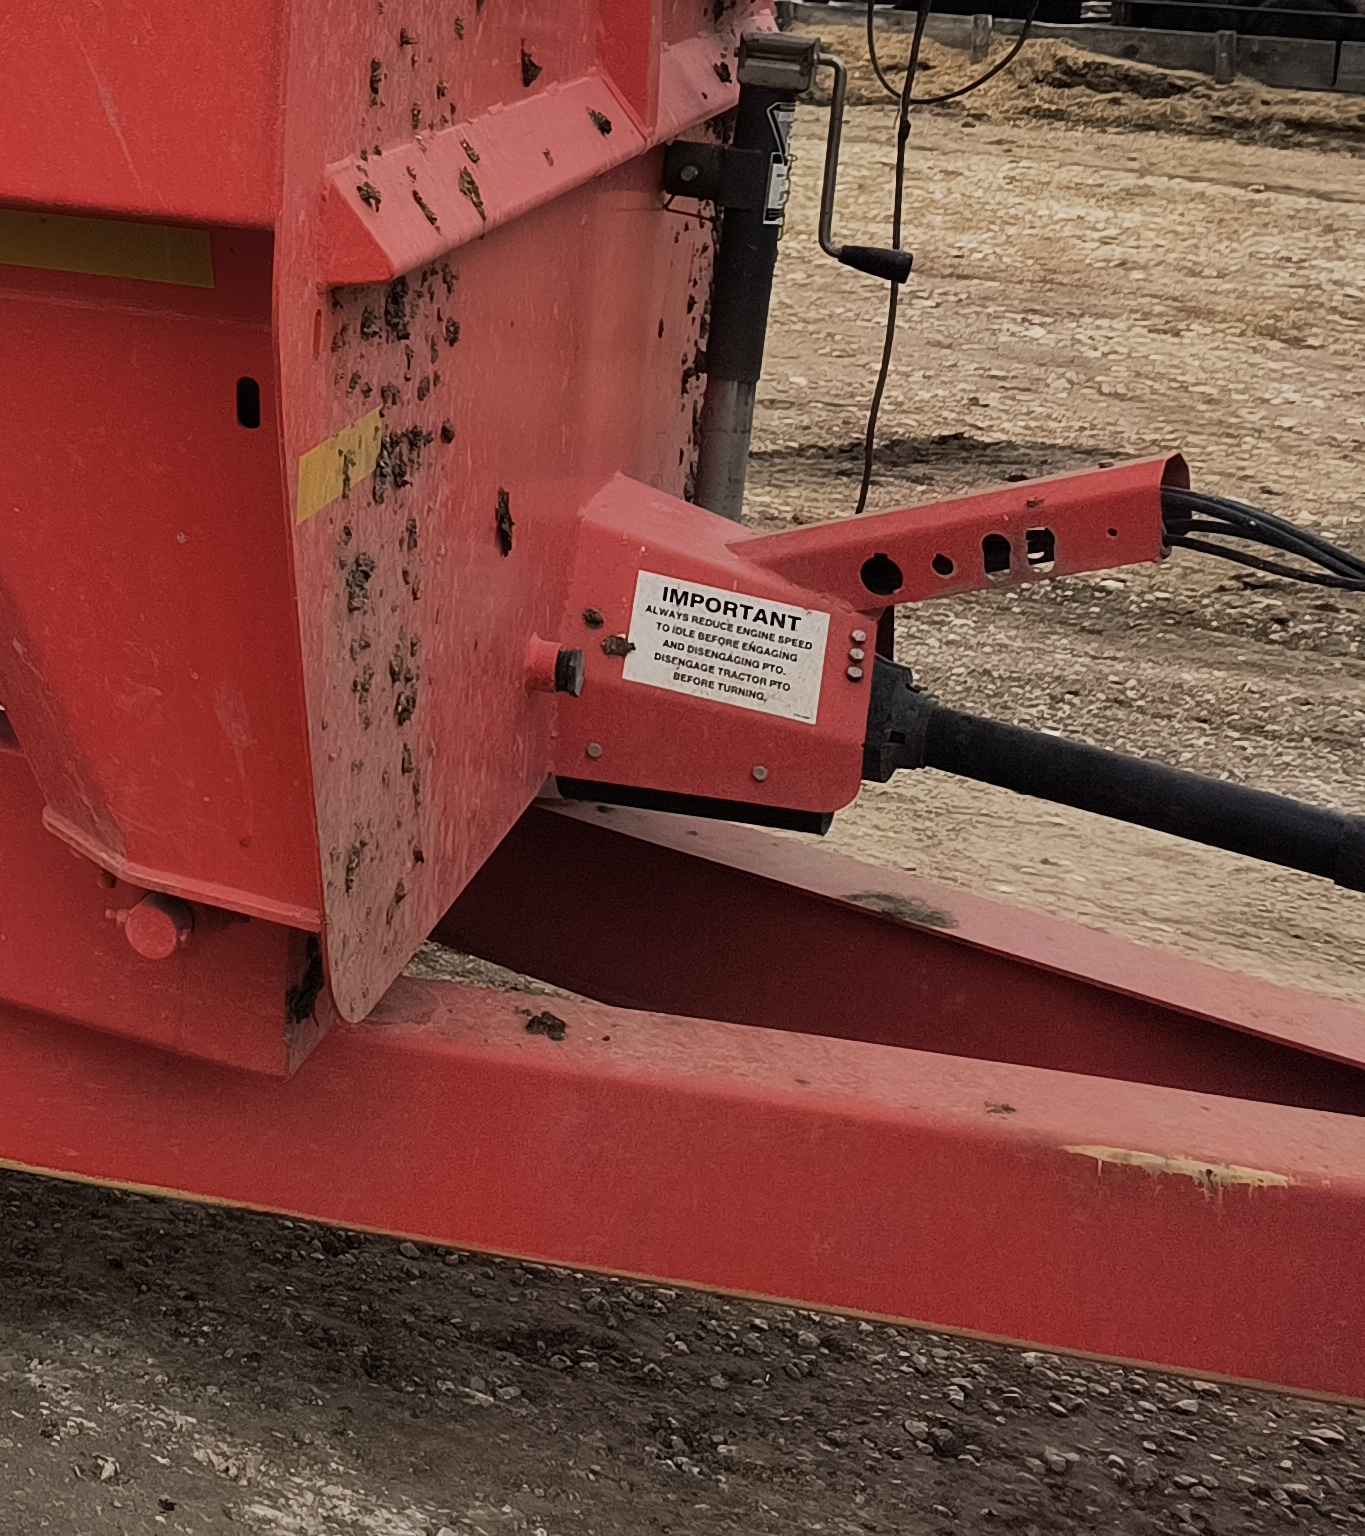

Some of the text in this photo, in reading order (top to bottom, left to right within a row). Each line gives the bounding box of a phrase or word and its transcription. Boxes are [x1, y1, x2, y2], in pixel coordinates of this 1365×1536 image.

[645, 604, 813, 650] ALWAYS REDUCE ENGINE SPEED
[662, 586, 802, 632] IMPORTANT
[656, 622, 798, 662] TO IDLE BEFORE ENGAGING
[662, 639, 786, 675] AND DISENGAGING PTO.
[654, 652, 791, 692] DISENGAGE TRACTOR PTO
[673, 671, 715, 689] BEFORE
